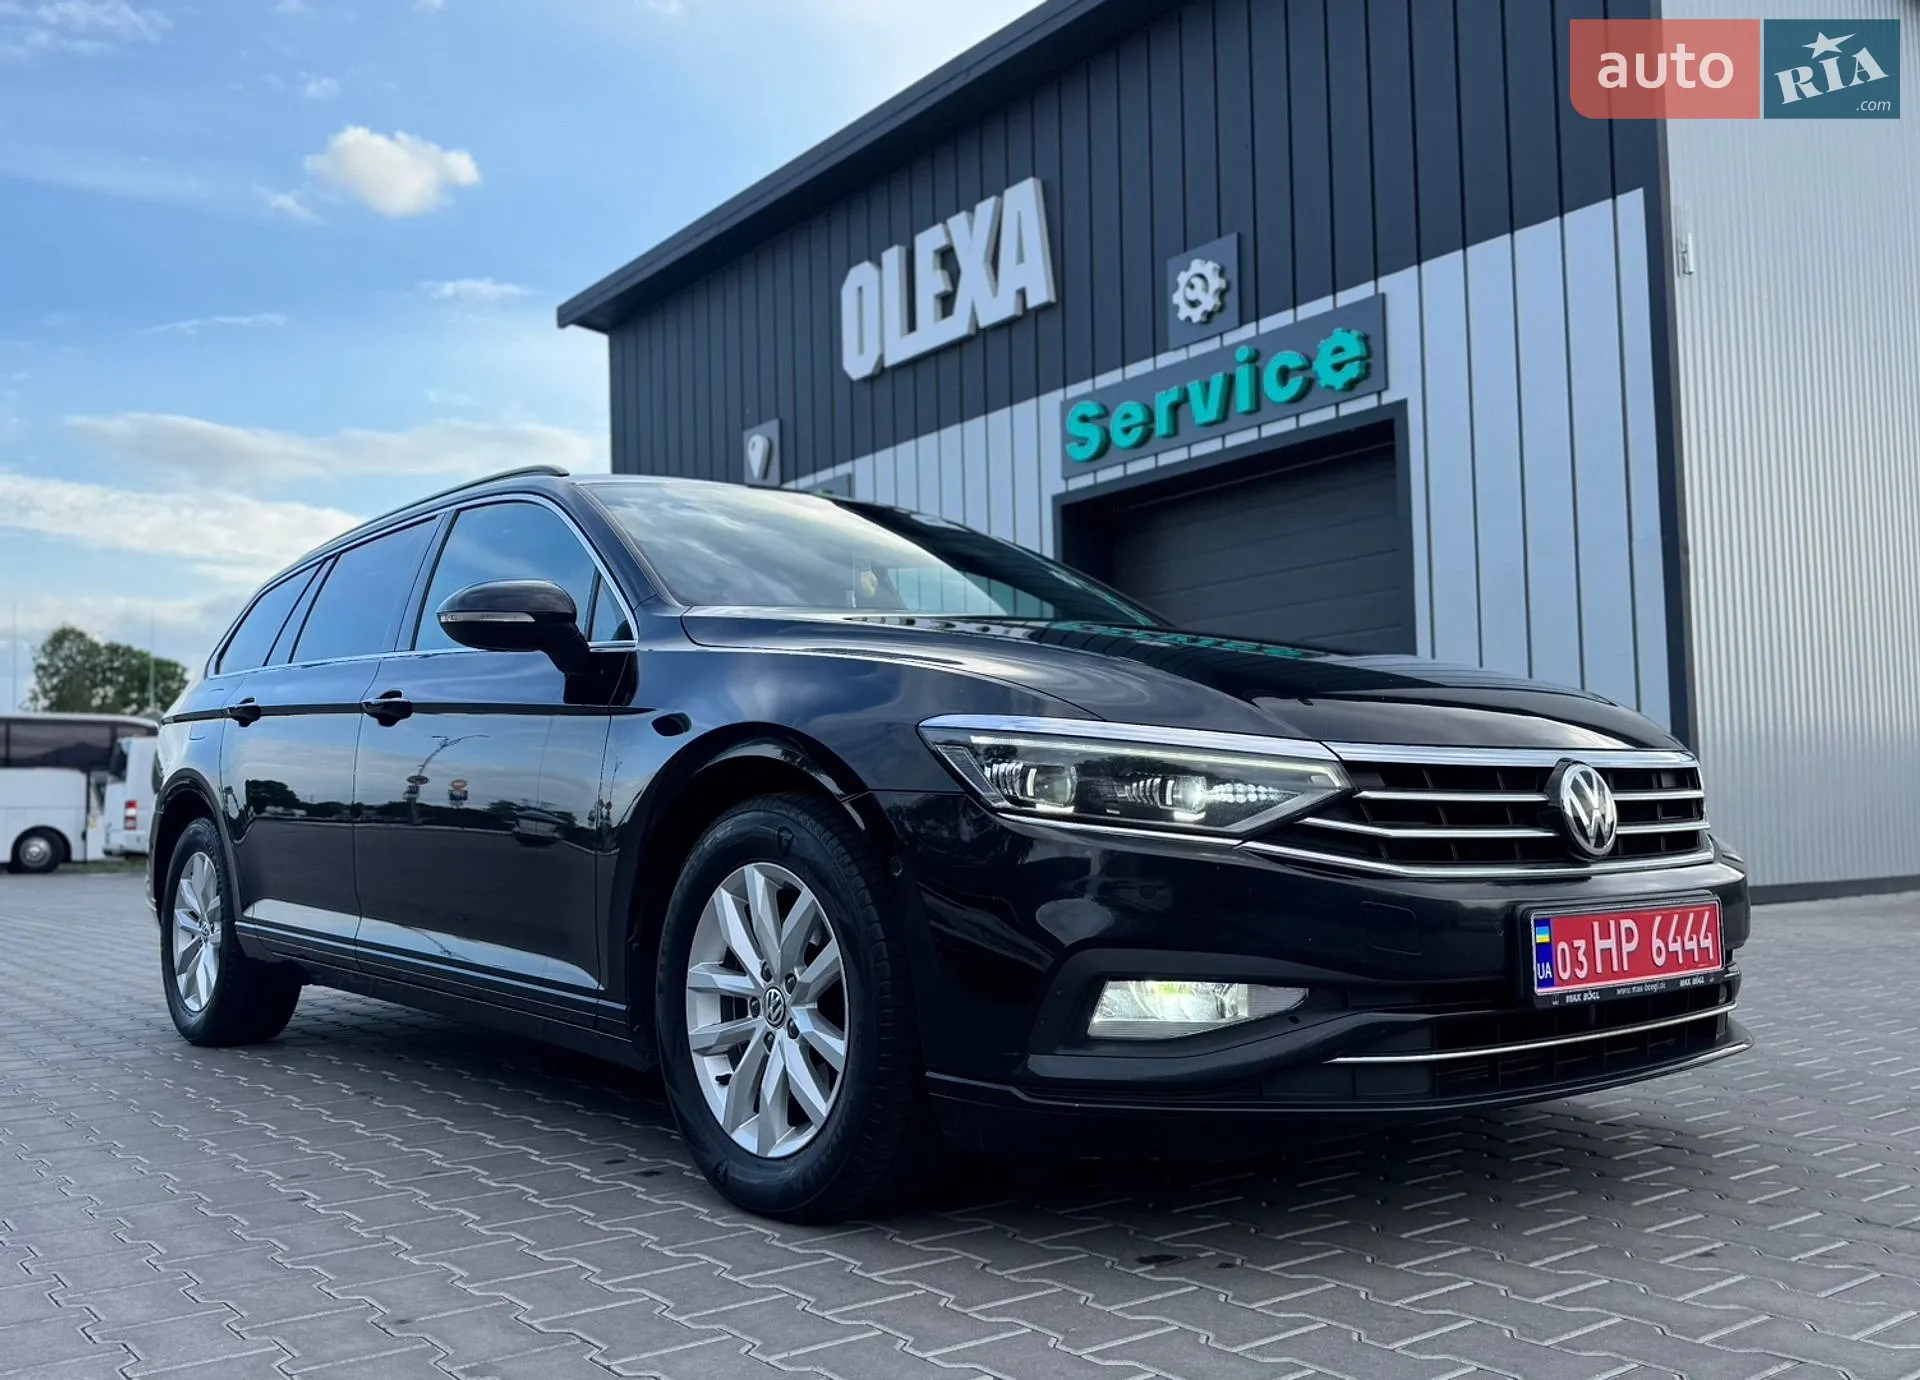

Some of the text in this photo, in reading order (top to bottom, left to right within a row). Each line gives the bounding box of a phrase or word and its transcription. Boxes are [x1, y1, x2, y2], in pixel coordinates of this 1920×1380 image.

[841, 177, 1055, 381] OLEXA
[1065, 327, 1371, 462] Service
[1537, 962, 1552, 979] UA
[1557, 911, 1713, 980] 03 HP 6444
